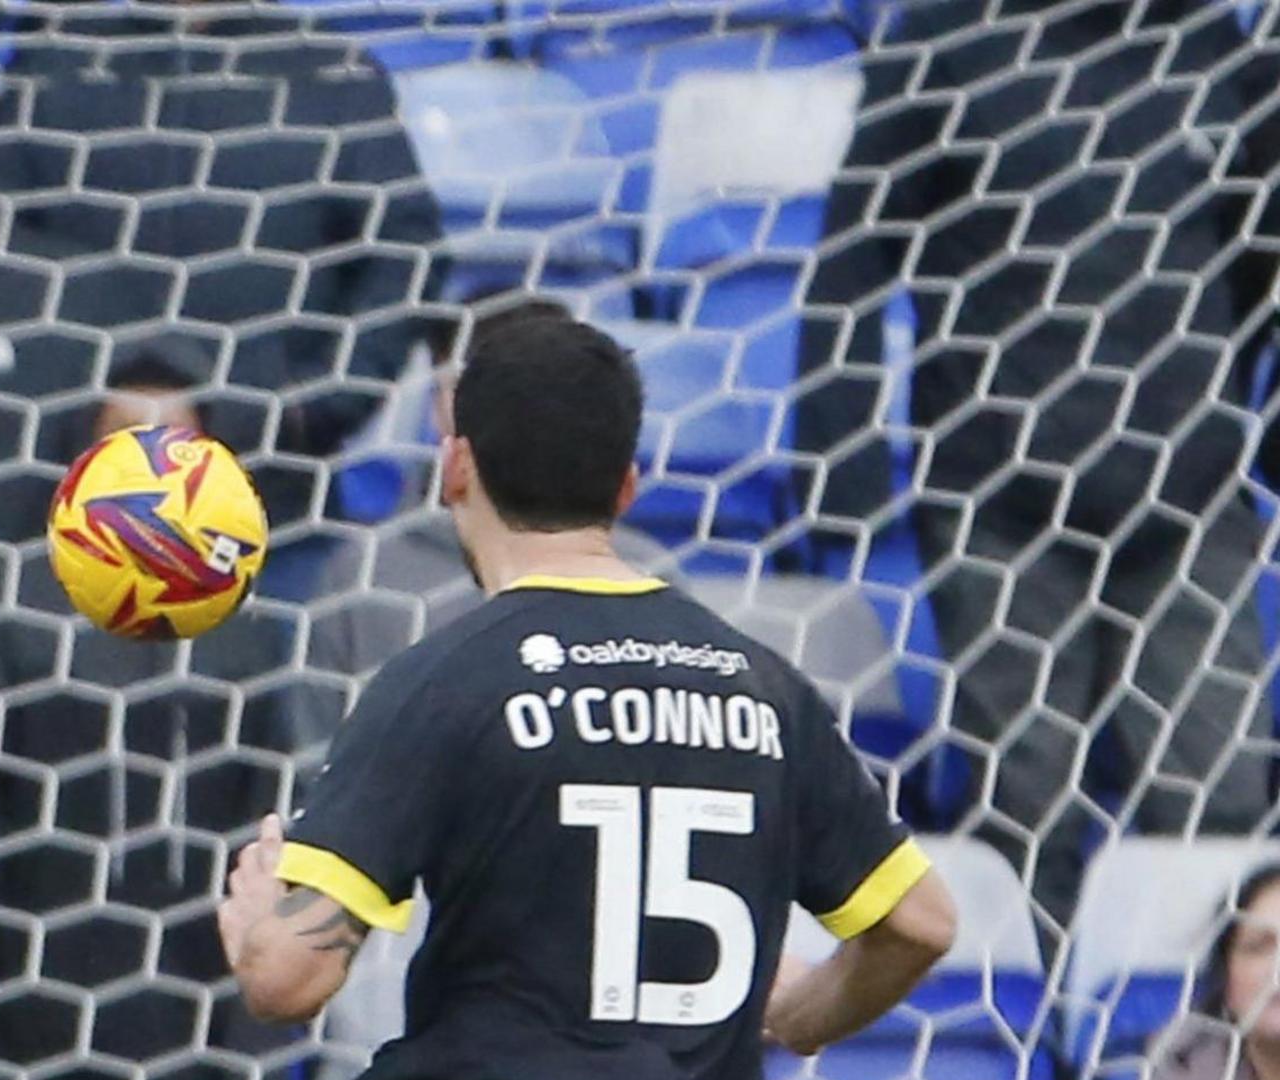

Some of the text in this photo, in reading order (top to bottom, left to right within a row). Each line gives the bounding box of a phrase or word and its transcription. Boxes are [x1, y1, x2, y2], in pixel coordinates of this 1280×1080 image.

[569, 638, 751, 676] oakbydesign
[504, 687, 784, 760] O'CONNOR
[559, 784, 757, 1026] 15
